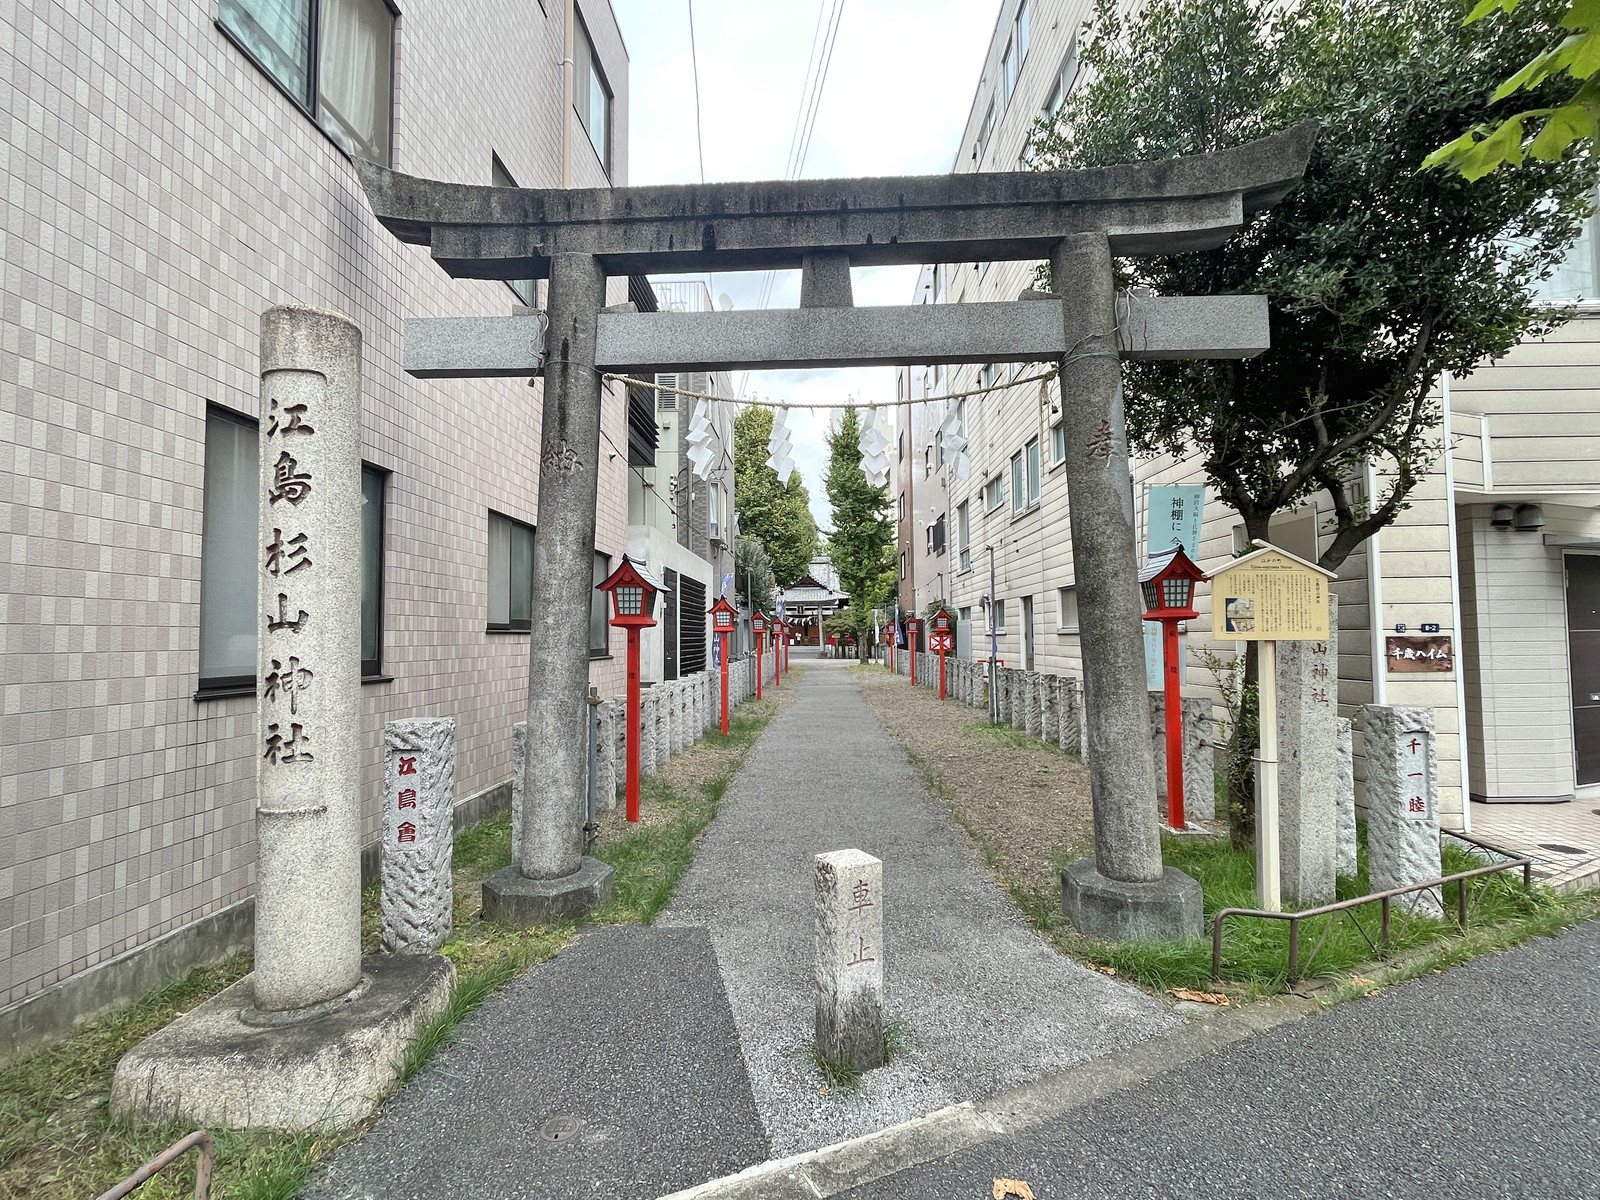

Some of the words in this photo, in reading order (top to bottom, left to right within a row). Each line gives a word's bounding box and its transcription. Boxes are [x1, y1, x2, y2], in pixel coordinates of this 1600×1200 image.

[264, 398, 315, 766] 江島杉山神社
[1392, 647, 1448, 660] 千歳ハイム
[1406, 737, 1426, 813] 千一睦
[846, 879, 876, 966] 車止
